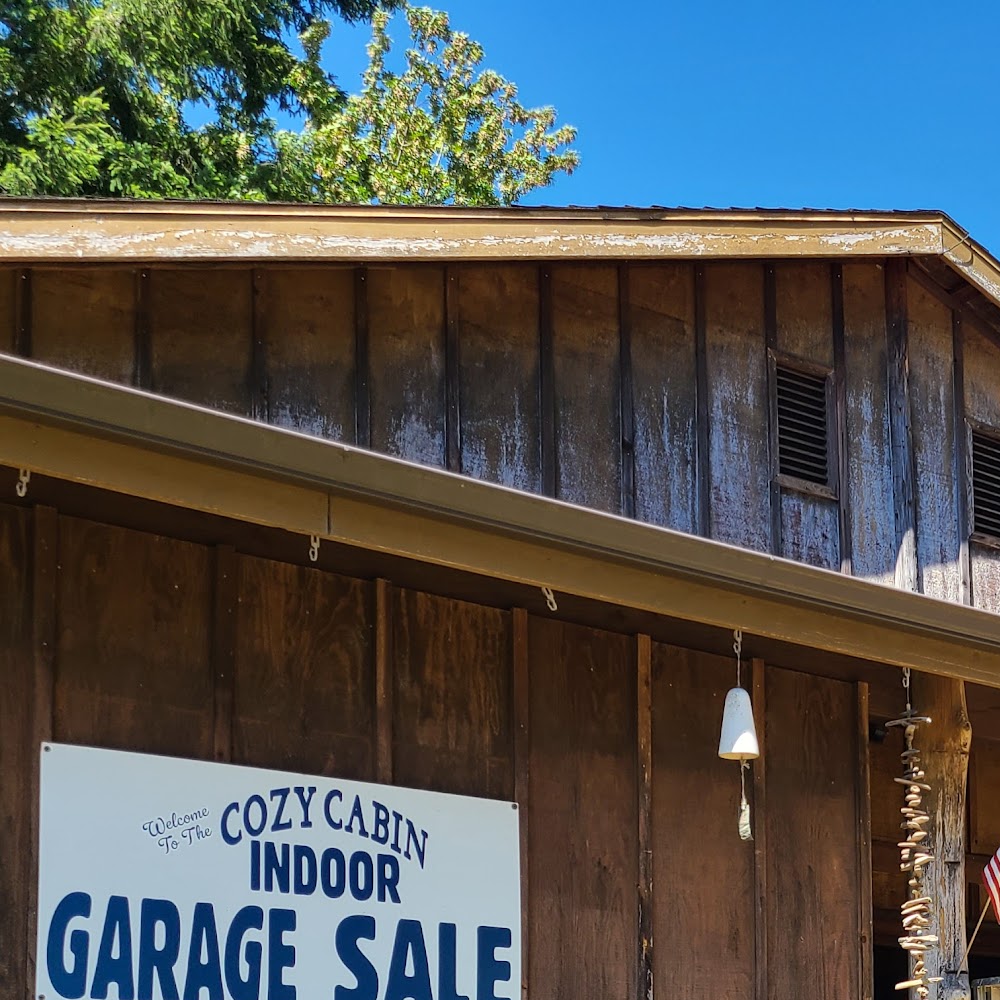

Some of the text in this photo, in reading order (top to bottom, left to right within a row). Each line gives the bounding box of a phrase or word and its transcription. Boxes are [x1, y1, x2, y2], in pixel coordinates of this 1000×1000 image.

[142, 806, 210, 837] Welcome
[158, 824, 213, 854] To The
[220, 786, 429, 870] COZY CABIN
[250, 840, 401, 904] INDOOR
